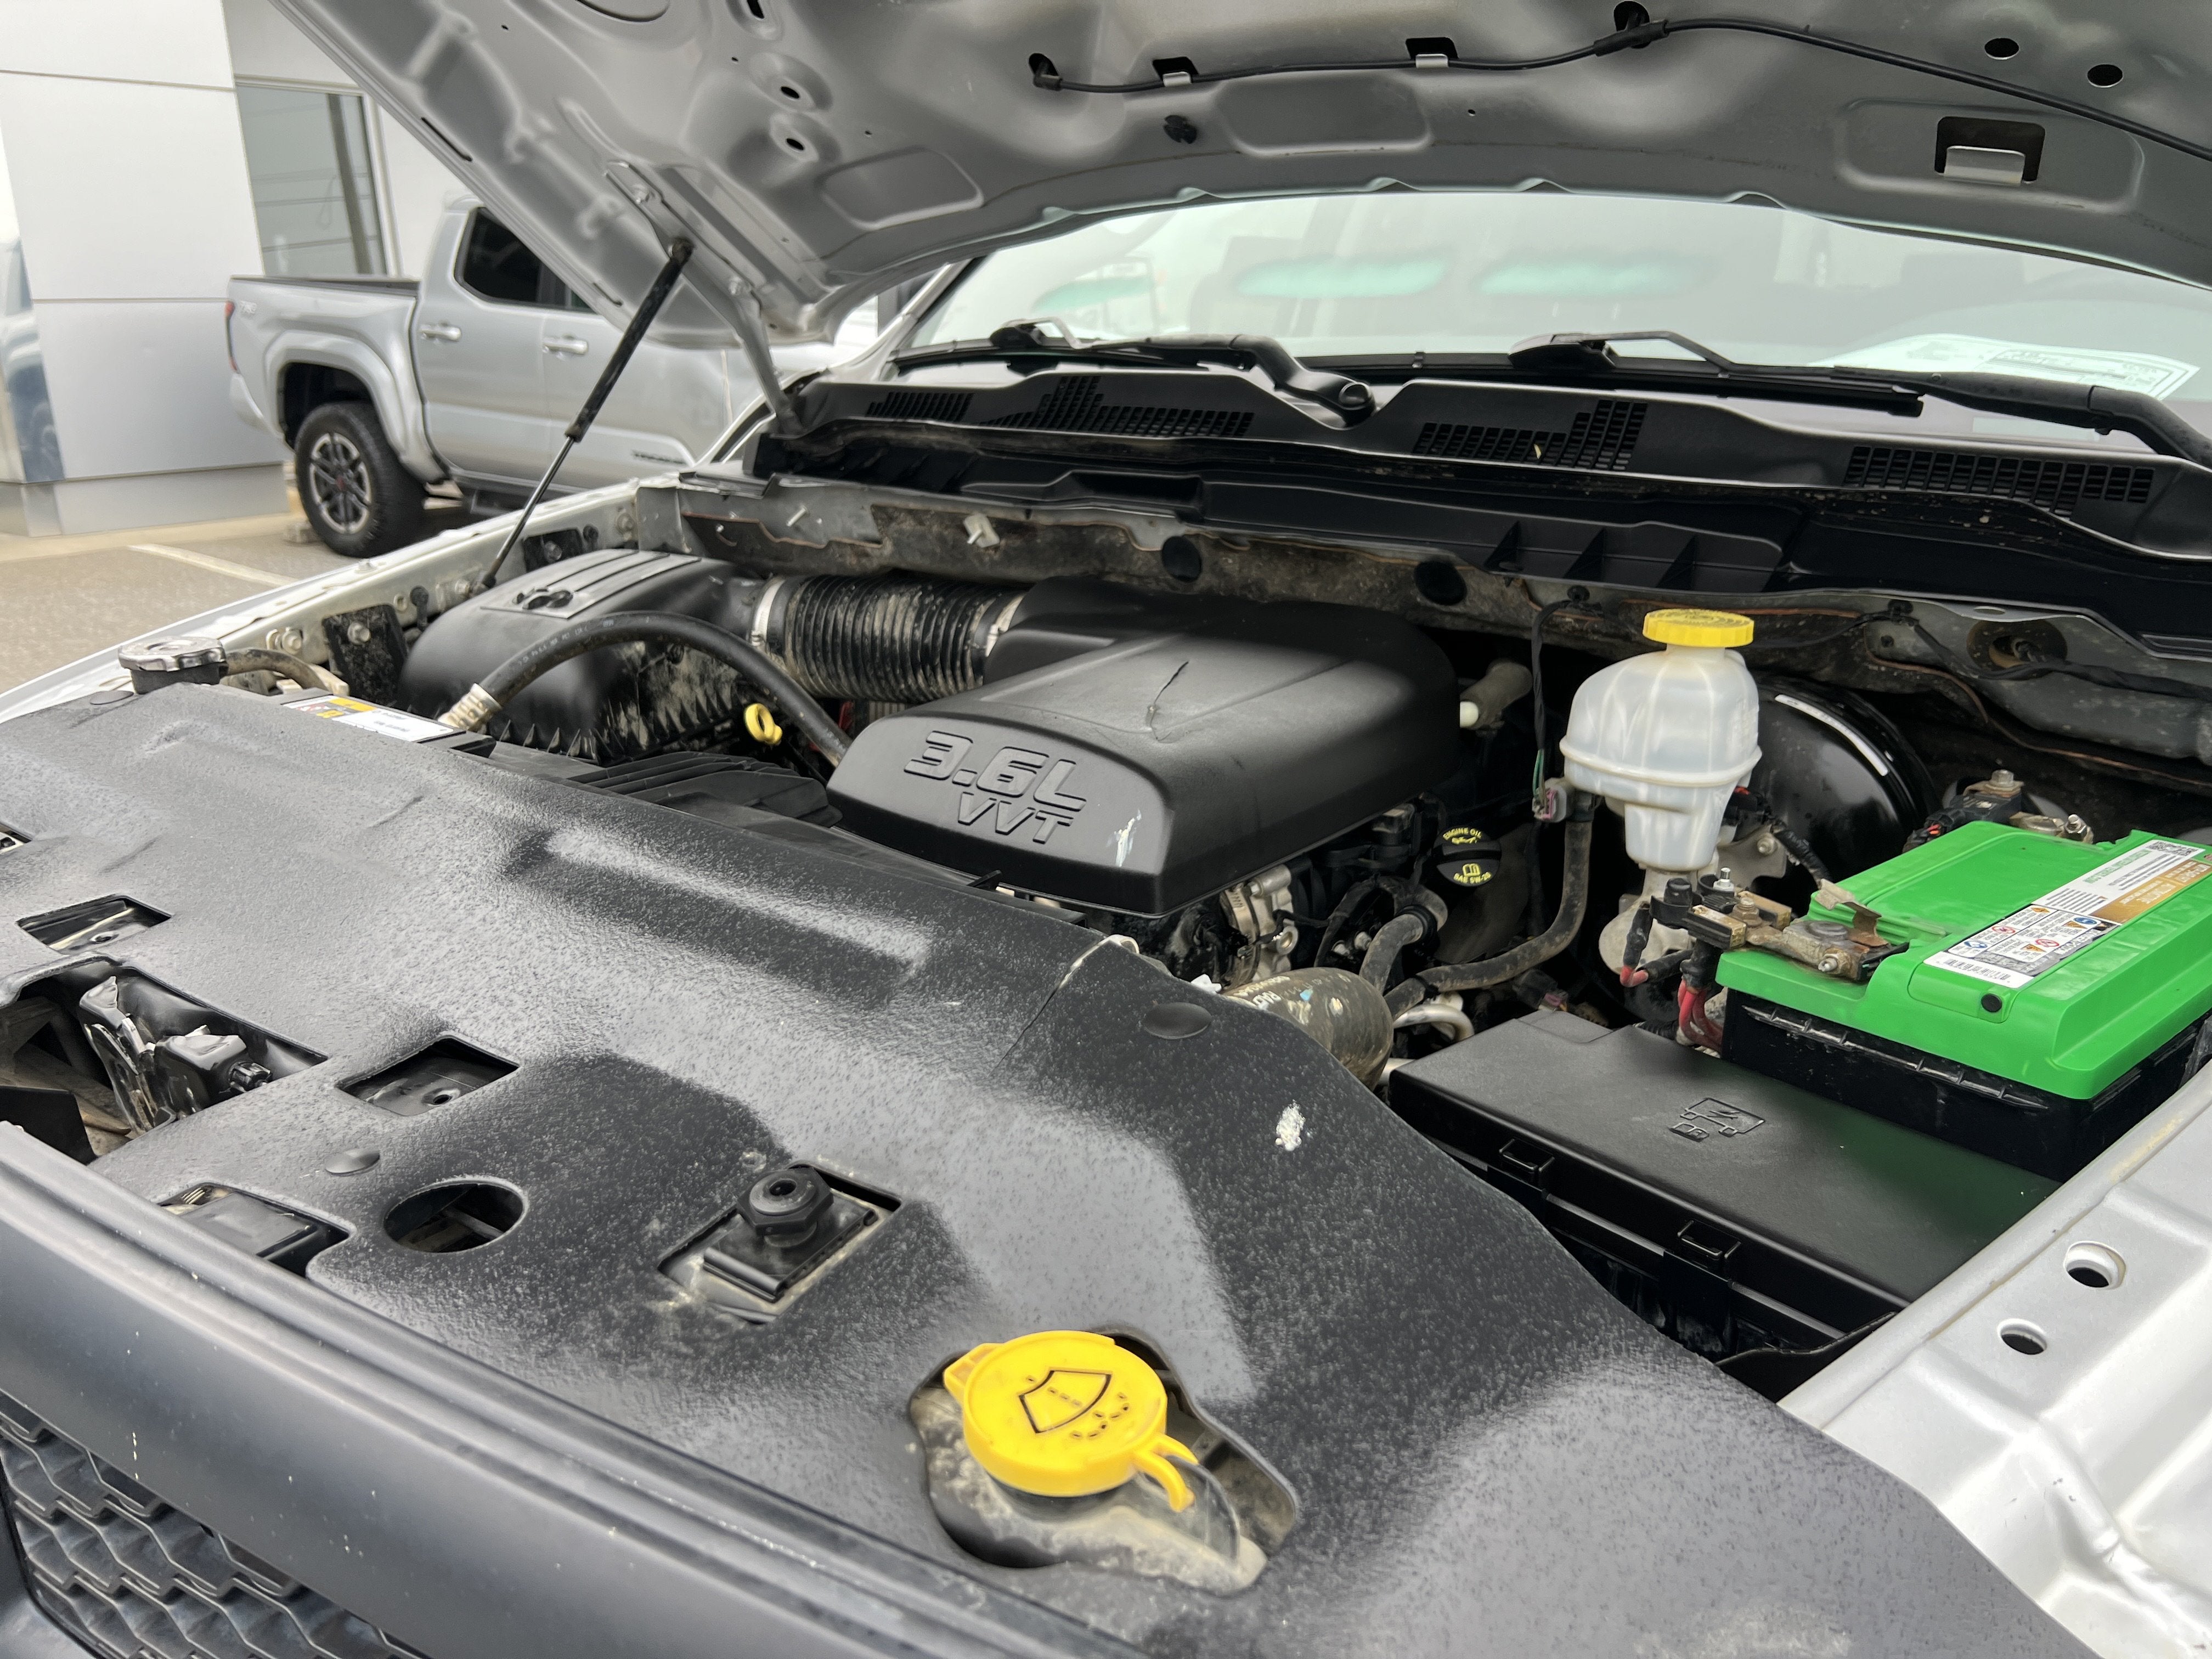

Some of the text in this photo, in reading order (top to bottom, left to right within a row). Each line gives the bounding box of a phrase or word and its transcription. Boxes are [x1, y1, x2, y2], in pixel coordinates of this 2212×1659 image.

[904, 731, 1087, 811] 3.6L
[958, 792, 1074, 844] VVT
[1443, 827, 1482, 840] ENGINE OIL
[1454, 873, 1468, 883] SAE
